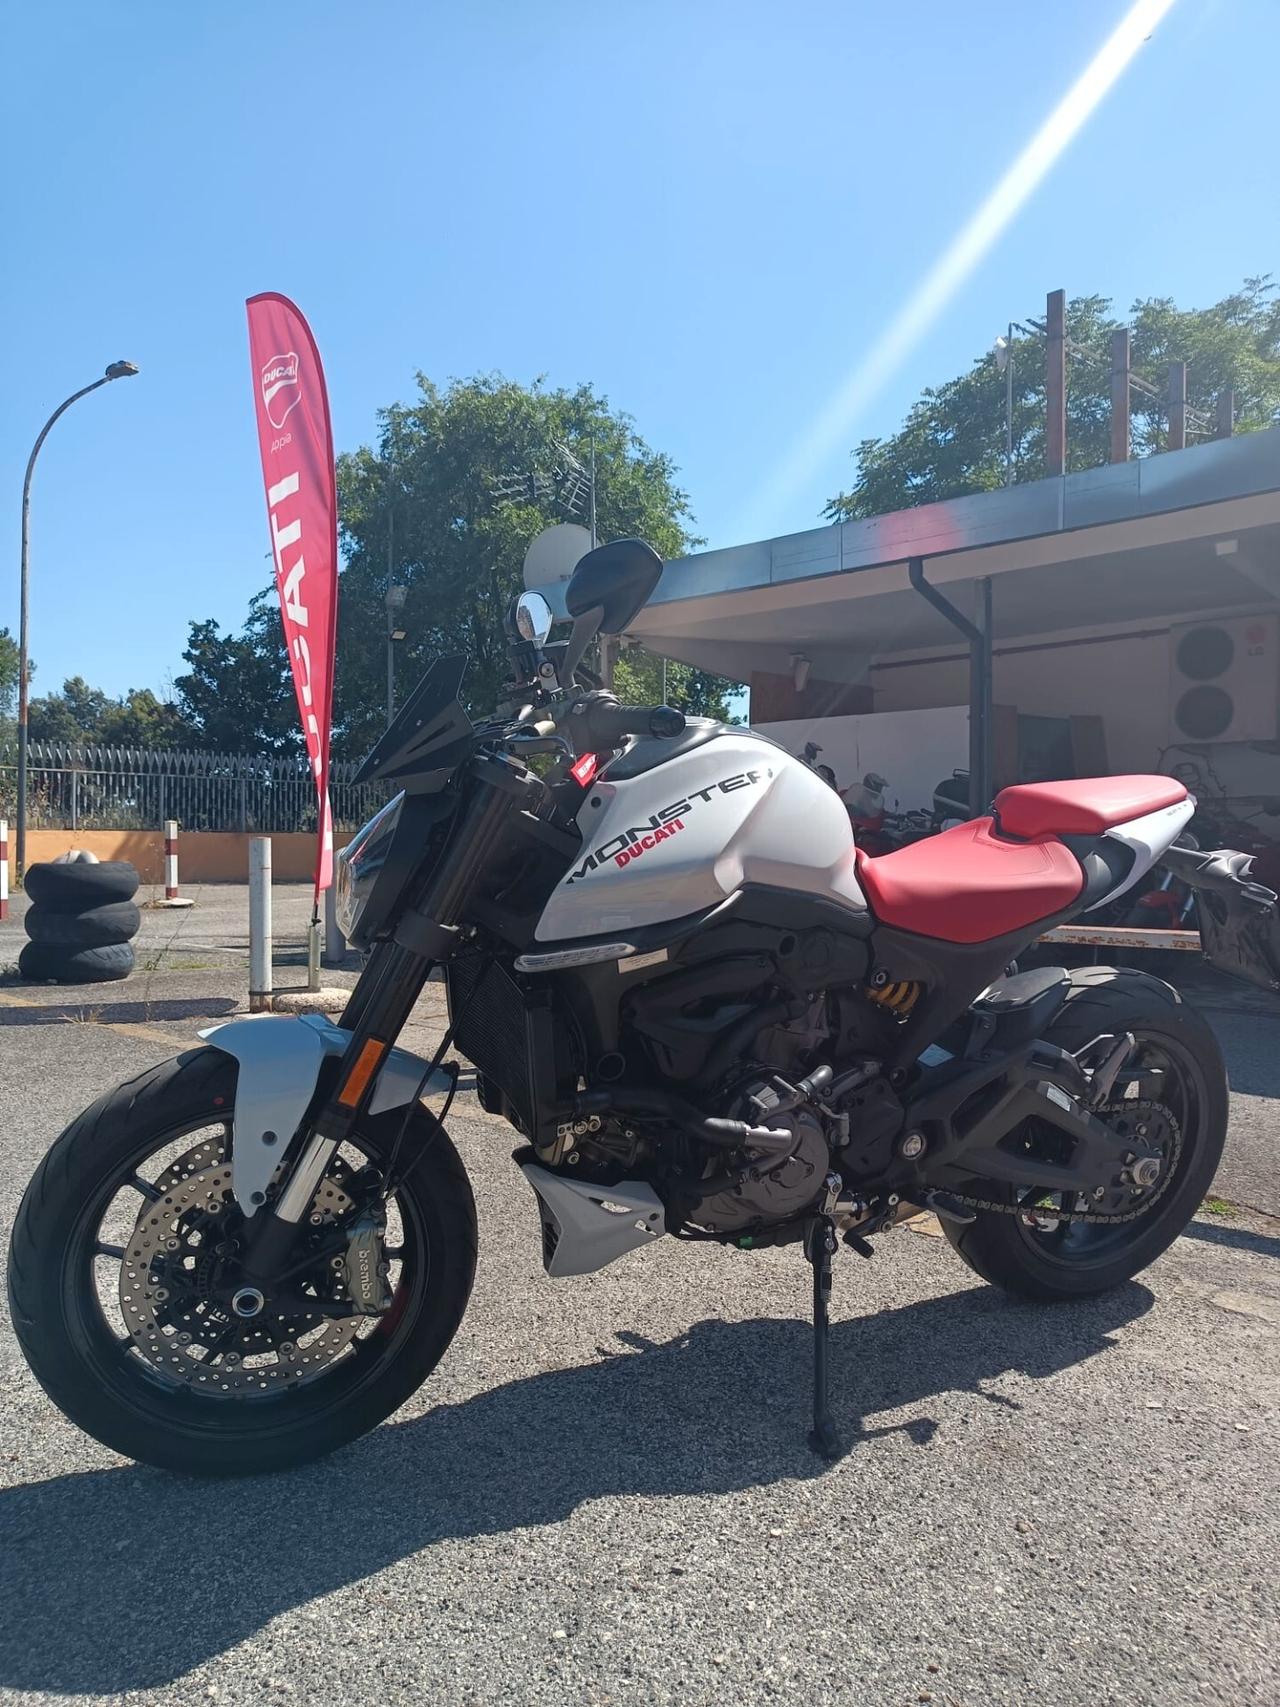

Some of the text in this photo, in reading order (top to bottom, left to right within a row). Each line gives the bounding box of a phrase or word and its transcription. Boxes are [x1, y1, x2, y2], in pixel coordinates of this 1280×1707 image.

[268, 472, 332, 850] UCATI
[613, 818, 686, 869] DUCATI
[359, 1249, 373, 1299] brembo
